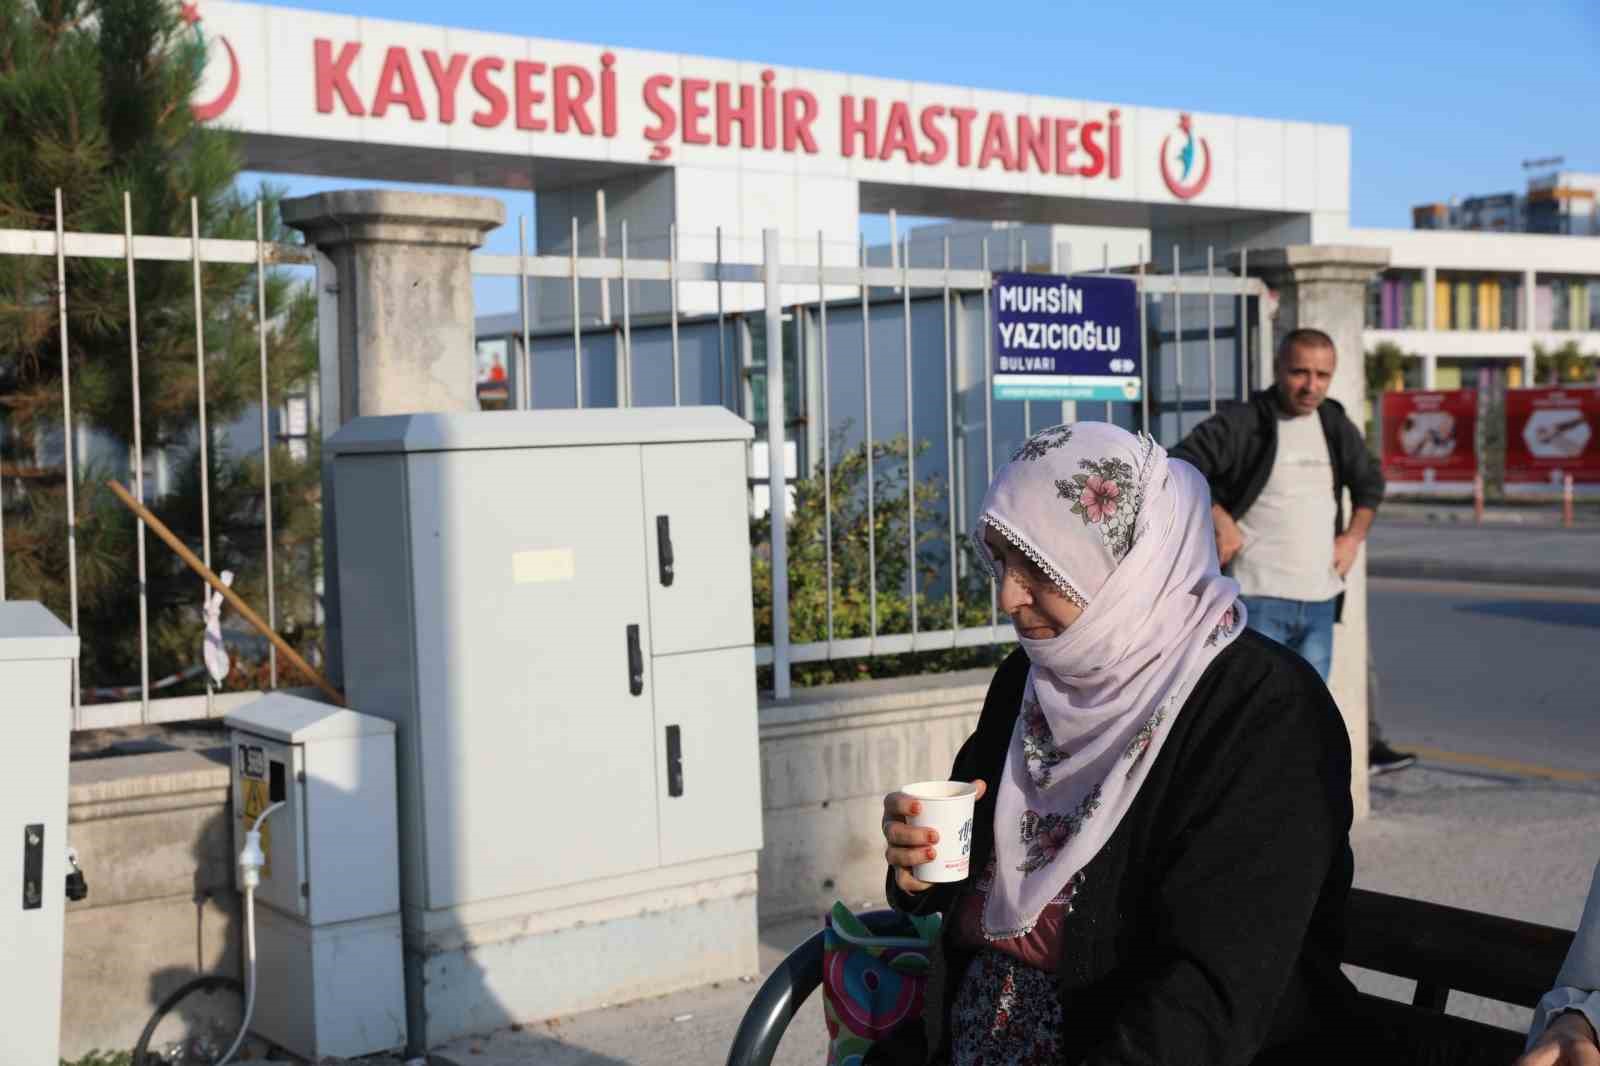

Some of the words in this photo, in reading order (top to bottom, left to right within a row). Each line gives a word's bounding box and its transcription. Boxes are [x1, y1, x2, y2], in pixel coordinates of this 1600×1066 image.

[313, 38, 619, 138] KAYSERİ
[642, 68, 819, 160] ŞEHİR
[840, 93, 1122, 180] HASTANESİ
[999, 283, 1083, 314] MUHSİN
[998, 320, 1121, 352] YAZICIOĞLU
[1000, 356, 1056, 372] BULVARI
